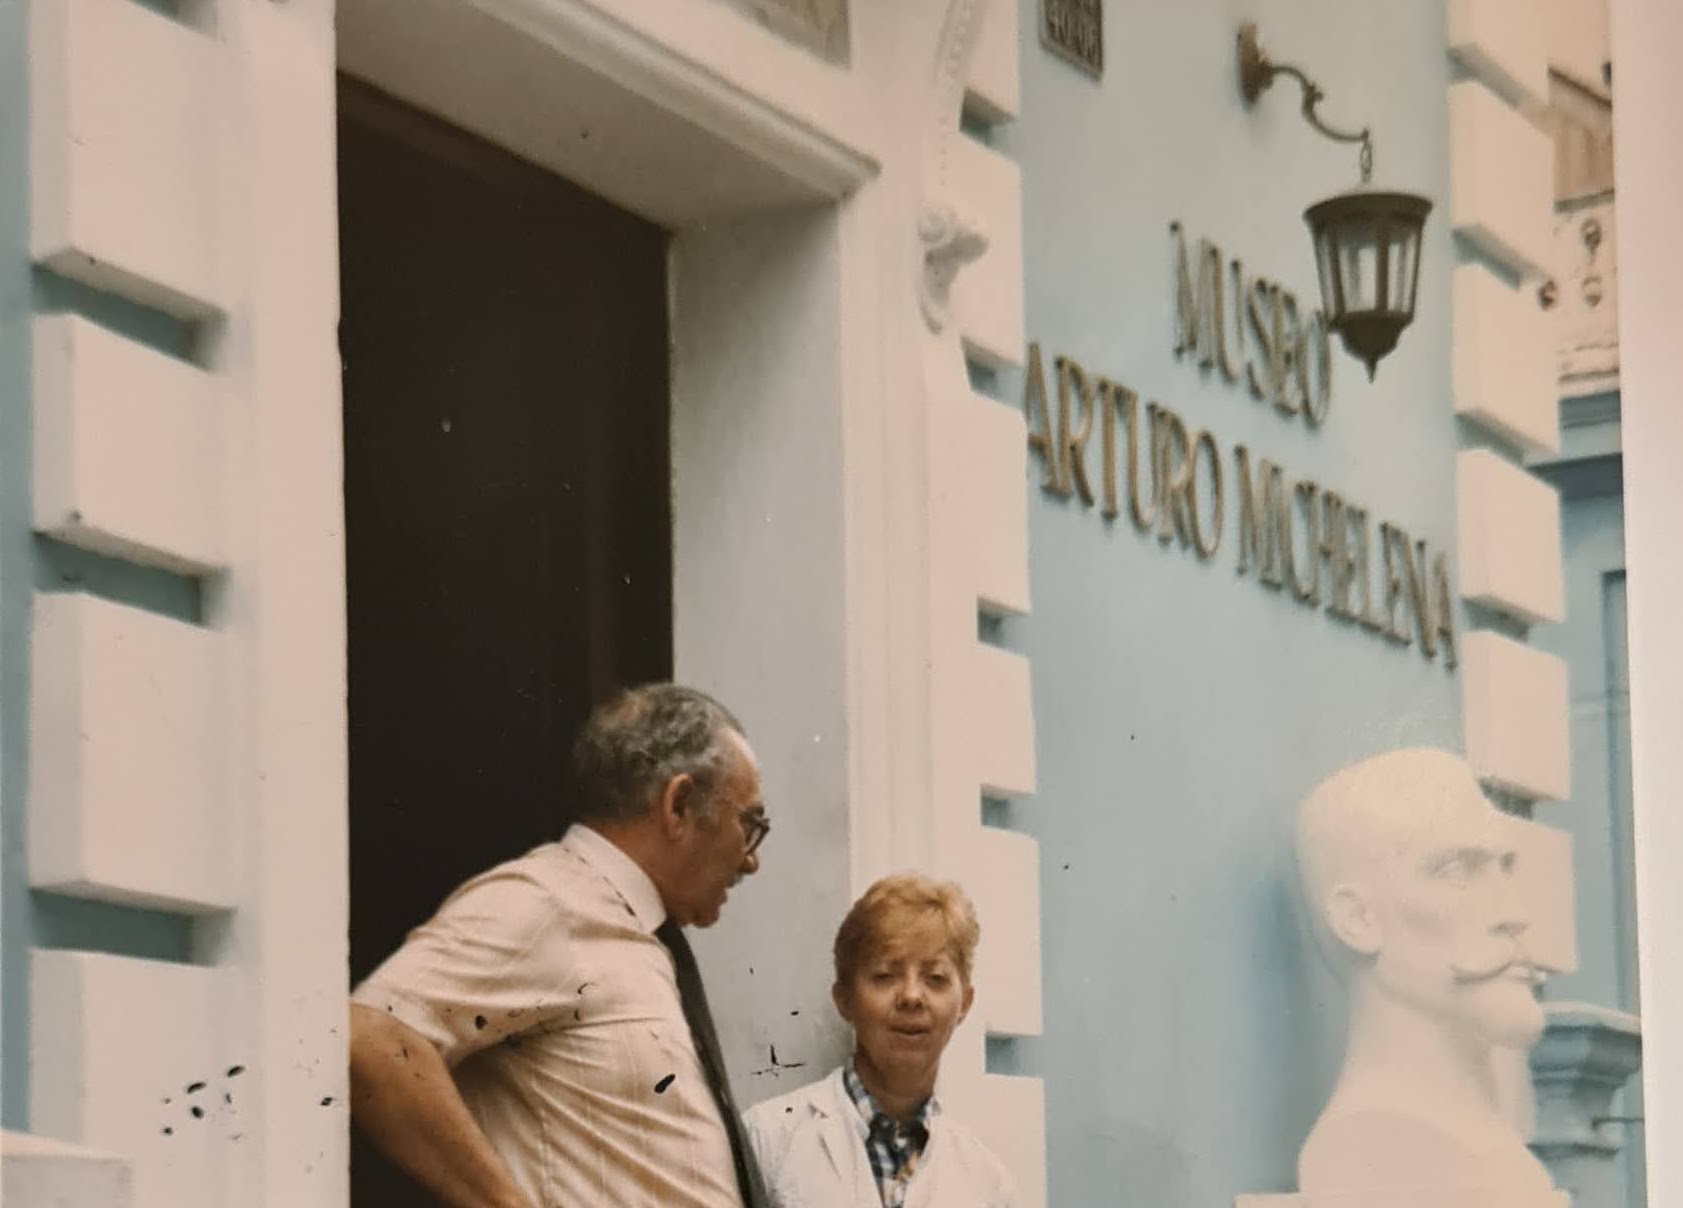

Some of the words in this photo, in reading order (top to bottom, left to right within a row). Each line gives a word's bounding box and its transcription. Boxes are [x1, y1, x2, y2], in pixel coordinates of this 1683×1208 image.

[1170, 220, 1332, 427] MUSEO
[1025, 341, 1223, 560] ARTURO
[1234, 445, 1458, 672] MICHELENA
